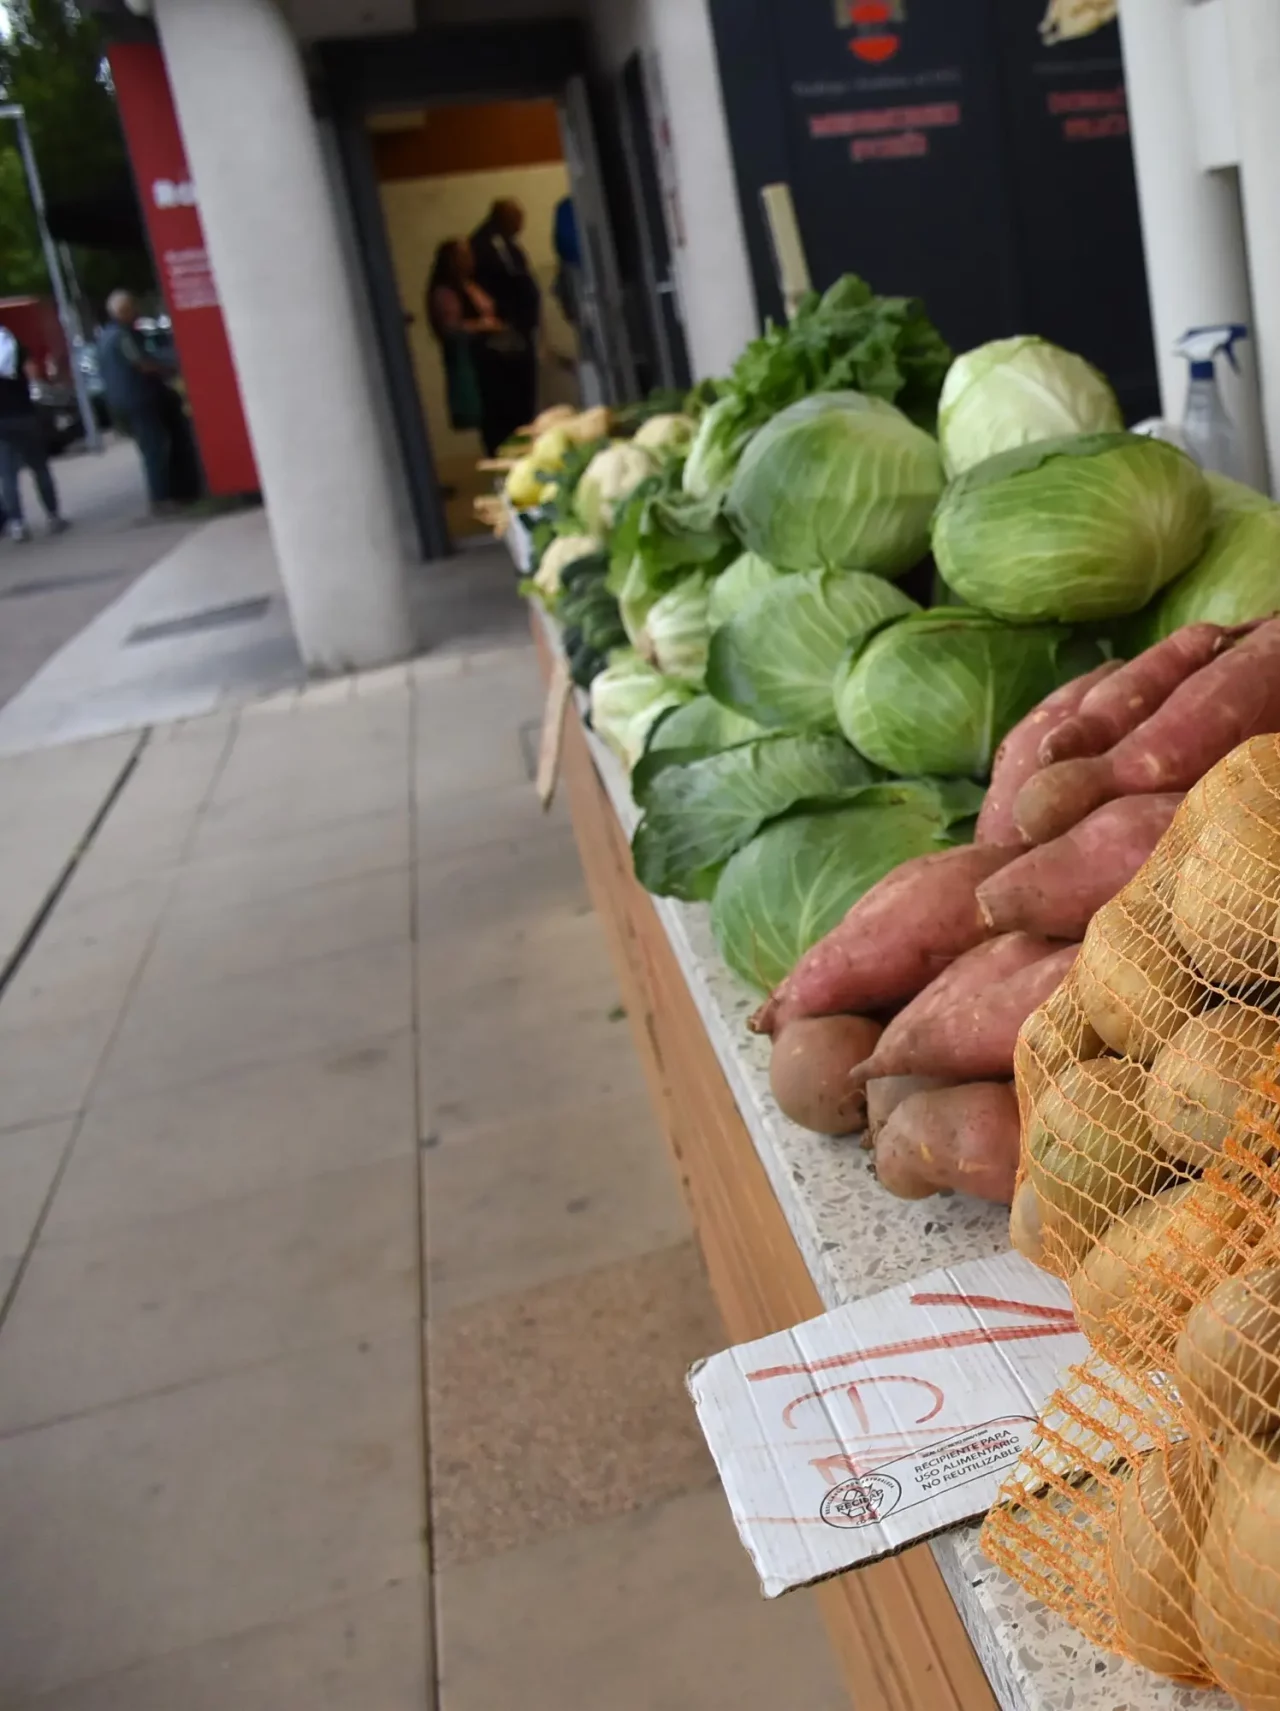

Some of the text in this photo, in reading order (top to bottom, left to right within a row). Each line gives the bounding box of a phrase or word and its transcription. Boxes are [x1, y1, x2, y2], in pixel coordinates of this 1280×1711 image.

[914, 1443, 980, 1473] RECIPIENTE
[980, 1429, 1012, 1446] PARA
[914, 1469, 940, 1483] USO
[942, 1436, 1020, 1475] ALIMENTARIO
[921, 1478, 941, 1491] NO
[942, 1445, 1022, 1482] REUTILIZABLE
